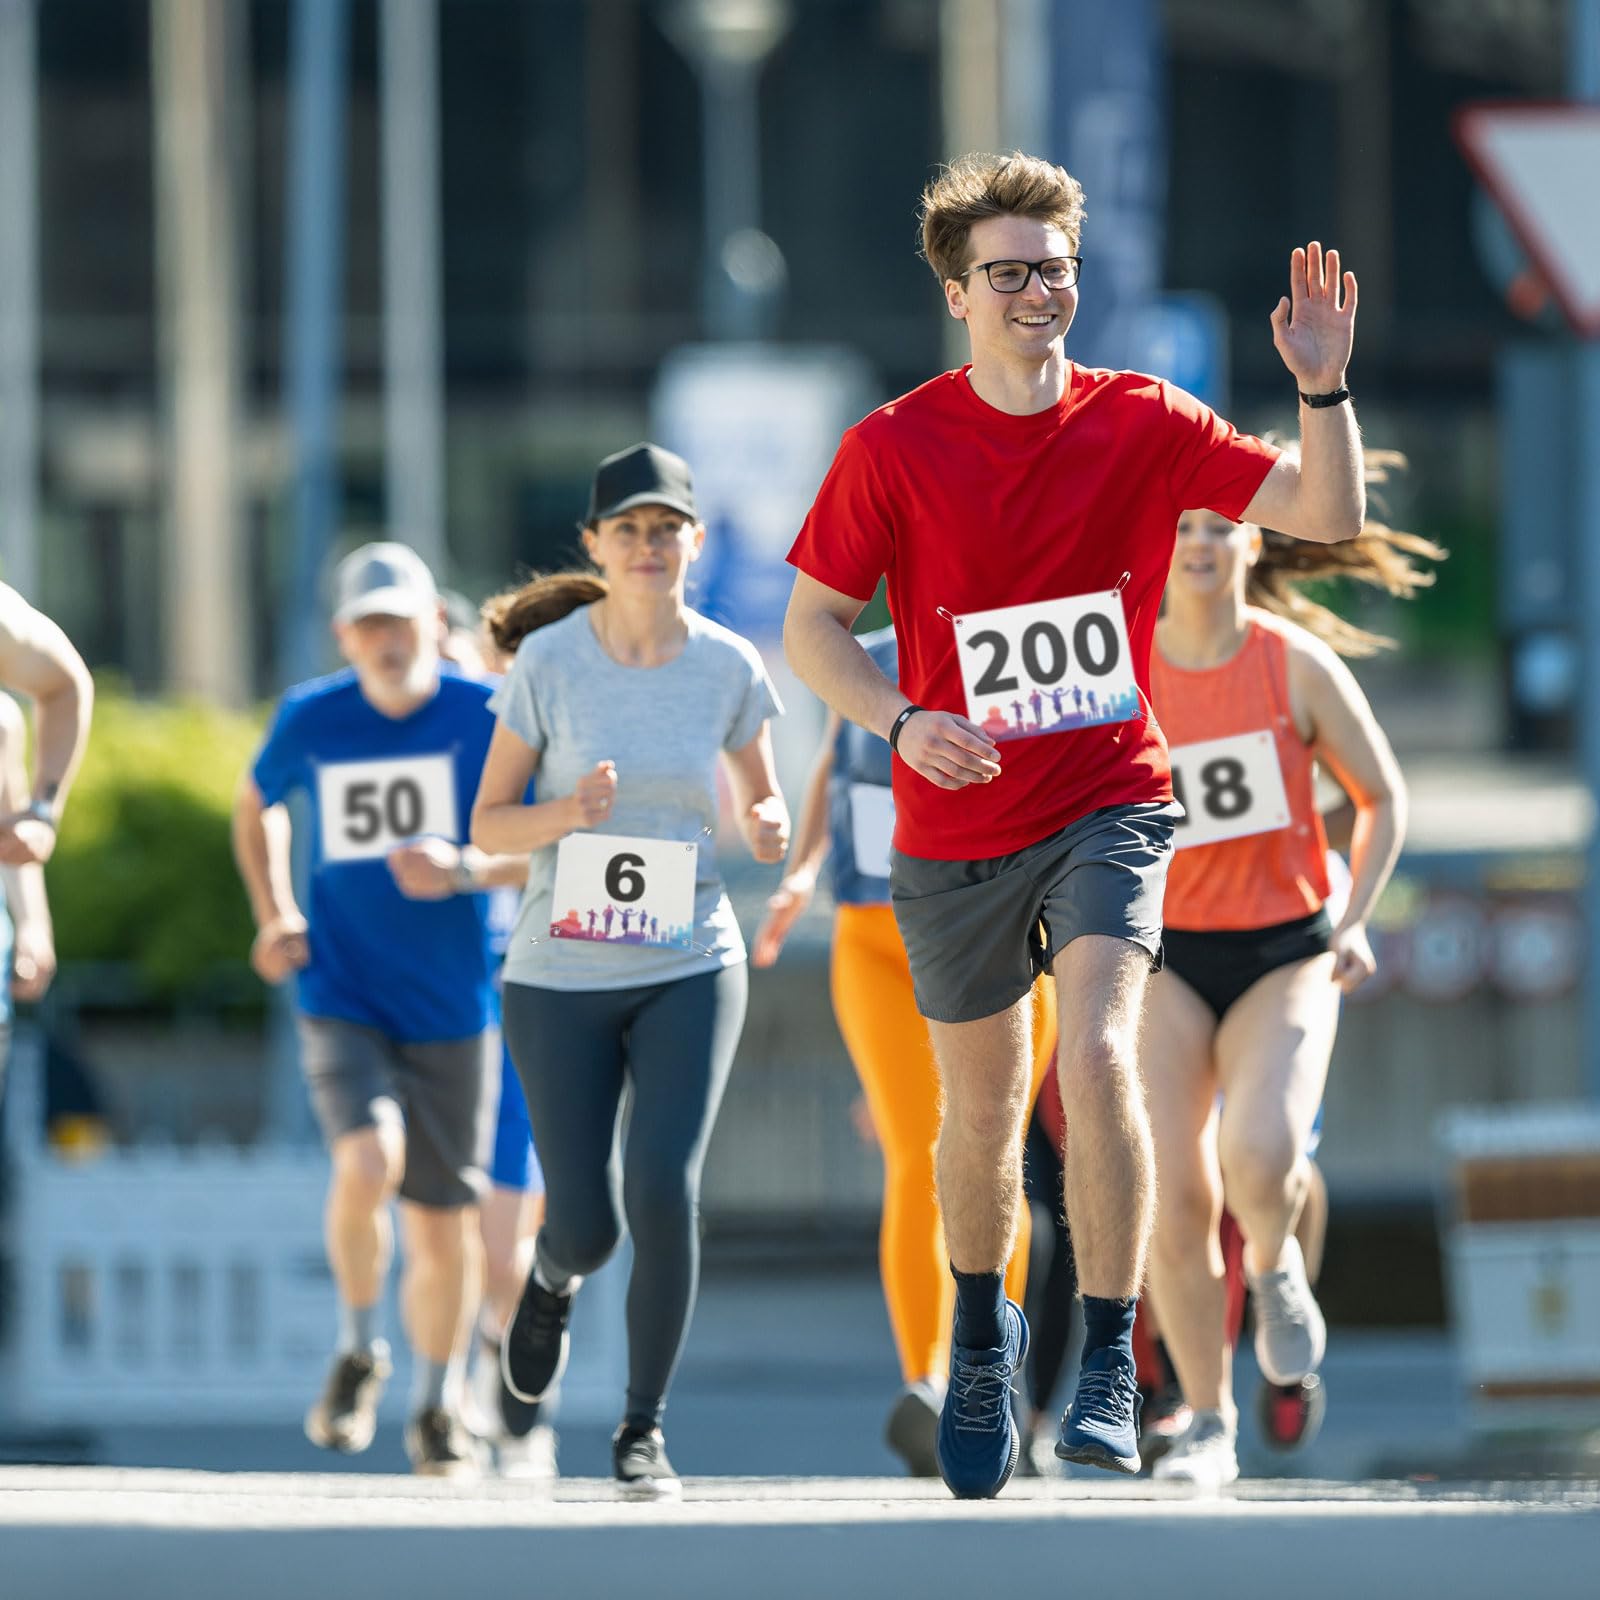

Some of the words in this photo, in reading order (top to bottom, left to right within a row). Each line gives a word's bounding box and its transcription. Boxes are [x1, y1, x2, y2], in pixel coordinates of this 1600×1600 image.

[965, 612, 1120, 697] 200
[344, 776, 424, 844] 50
[605, 852, 646, 902] 6
